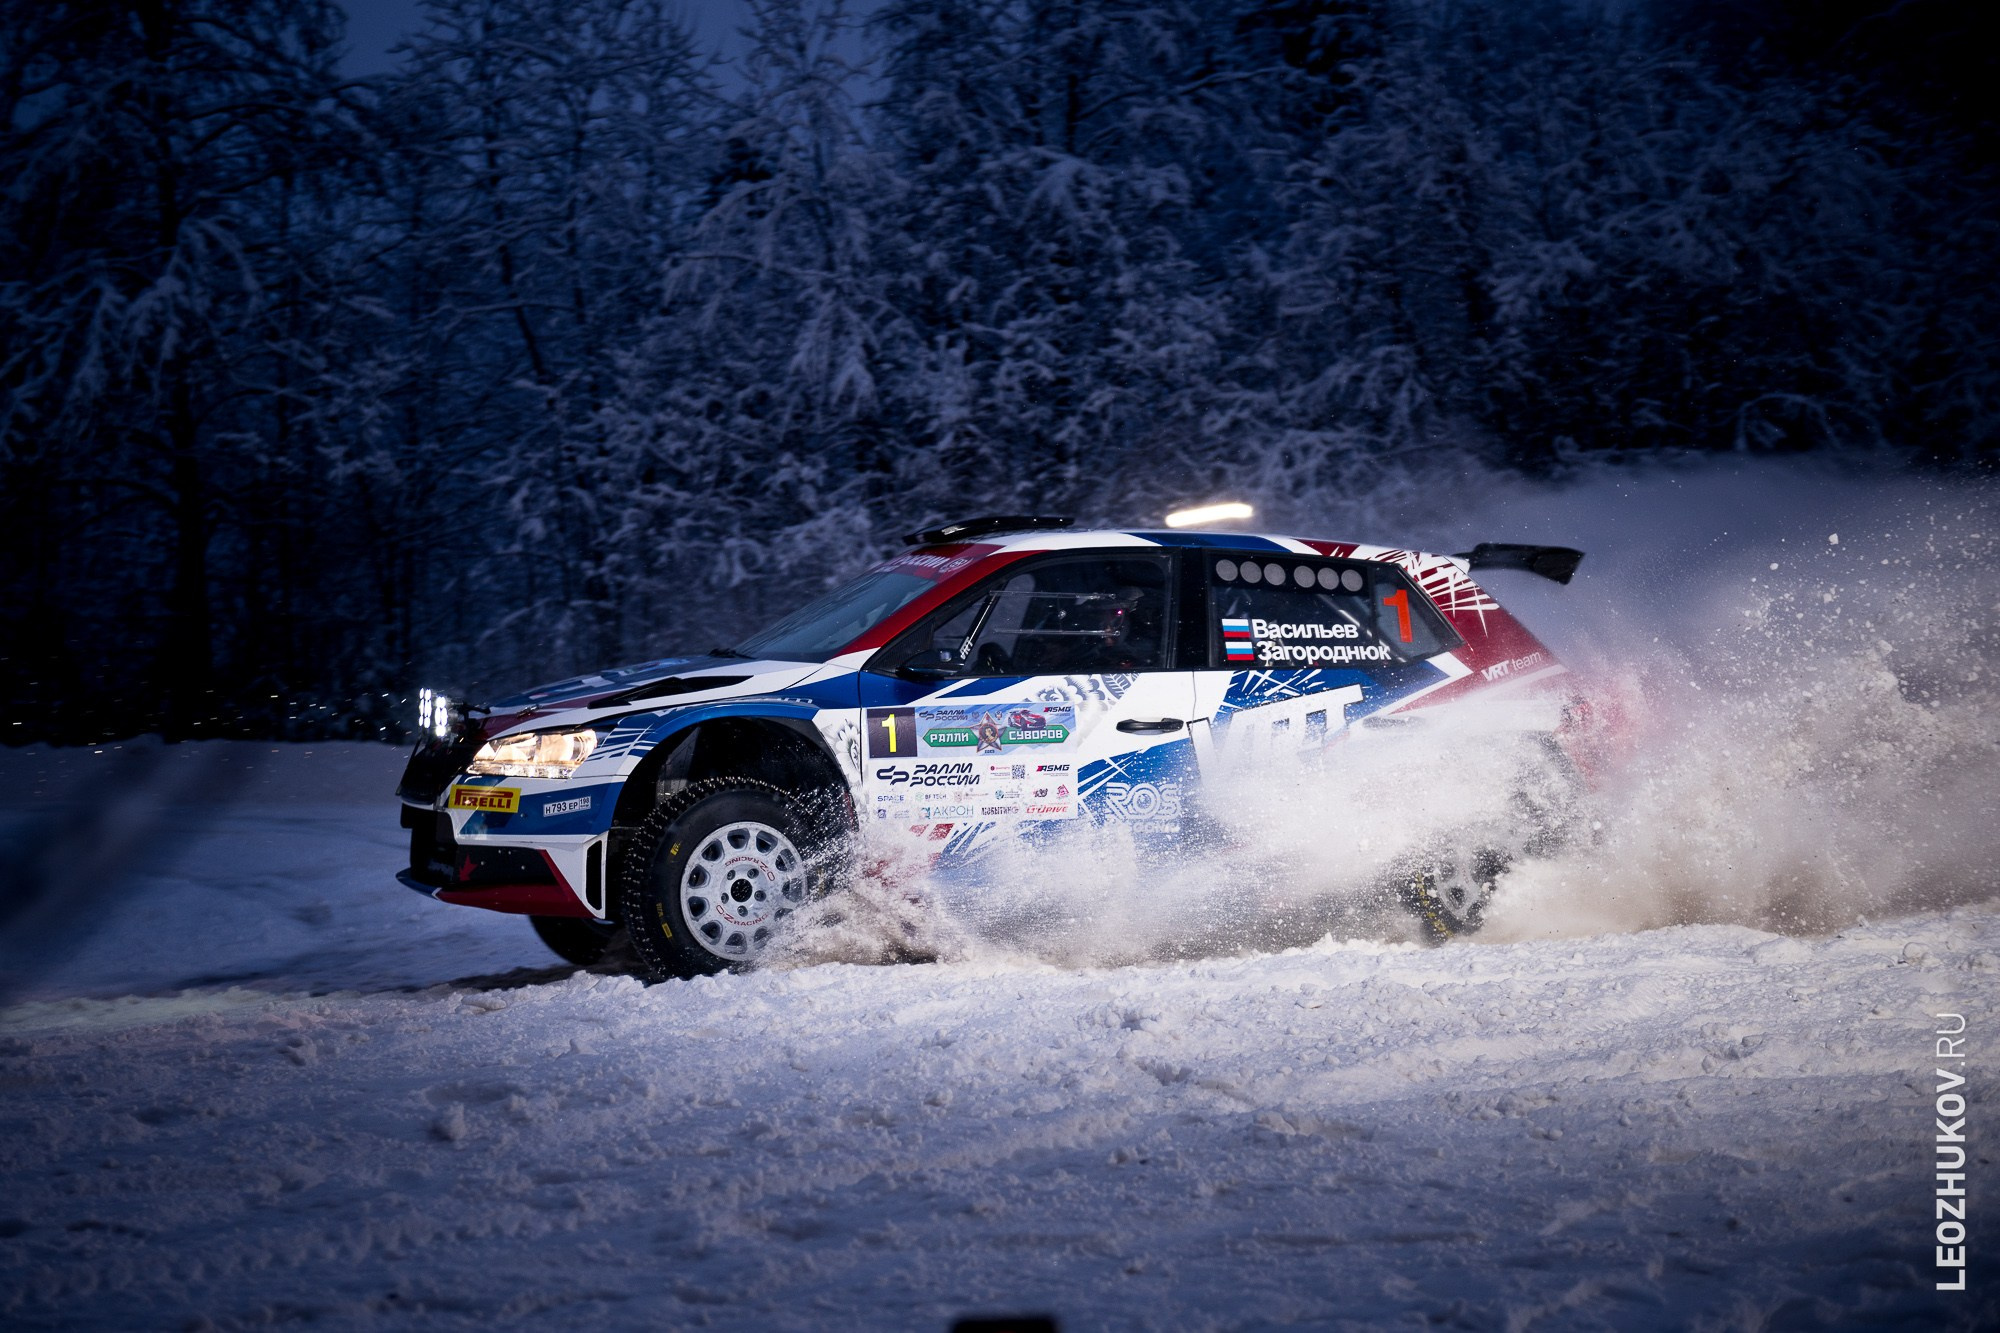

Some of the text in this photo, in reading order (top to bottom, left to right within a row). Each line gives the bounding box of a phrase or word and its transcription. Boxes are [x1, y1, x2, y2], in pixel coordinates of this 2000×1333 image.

[1383, 589, 1413, 643] 1
[1251, 618, 1359, 639] Васильев
[1256, 641, 1391, 665] Загороднюк
[1481, 652, 1541, 681] VRT team
[881, 713, 897, 753] 1
[930, 729, 1063, 743] РАЛЛИ СУВОРОВ
[913, 763, 973, 775] РАЛЛИ
[1037, 764, 1070, 772] ASMG
[910, 775, 980, 787] РОССИИ
[454, 788, 514, 809] PIRELLI
[551, 802, 567, 813] 793
[933, 805, 973, 816] АКРОН
